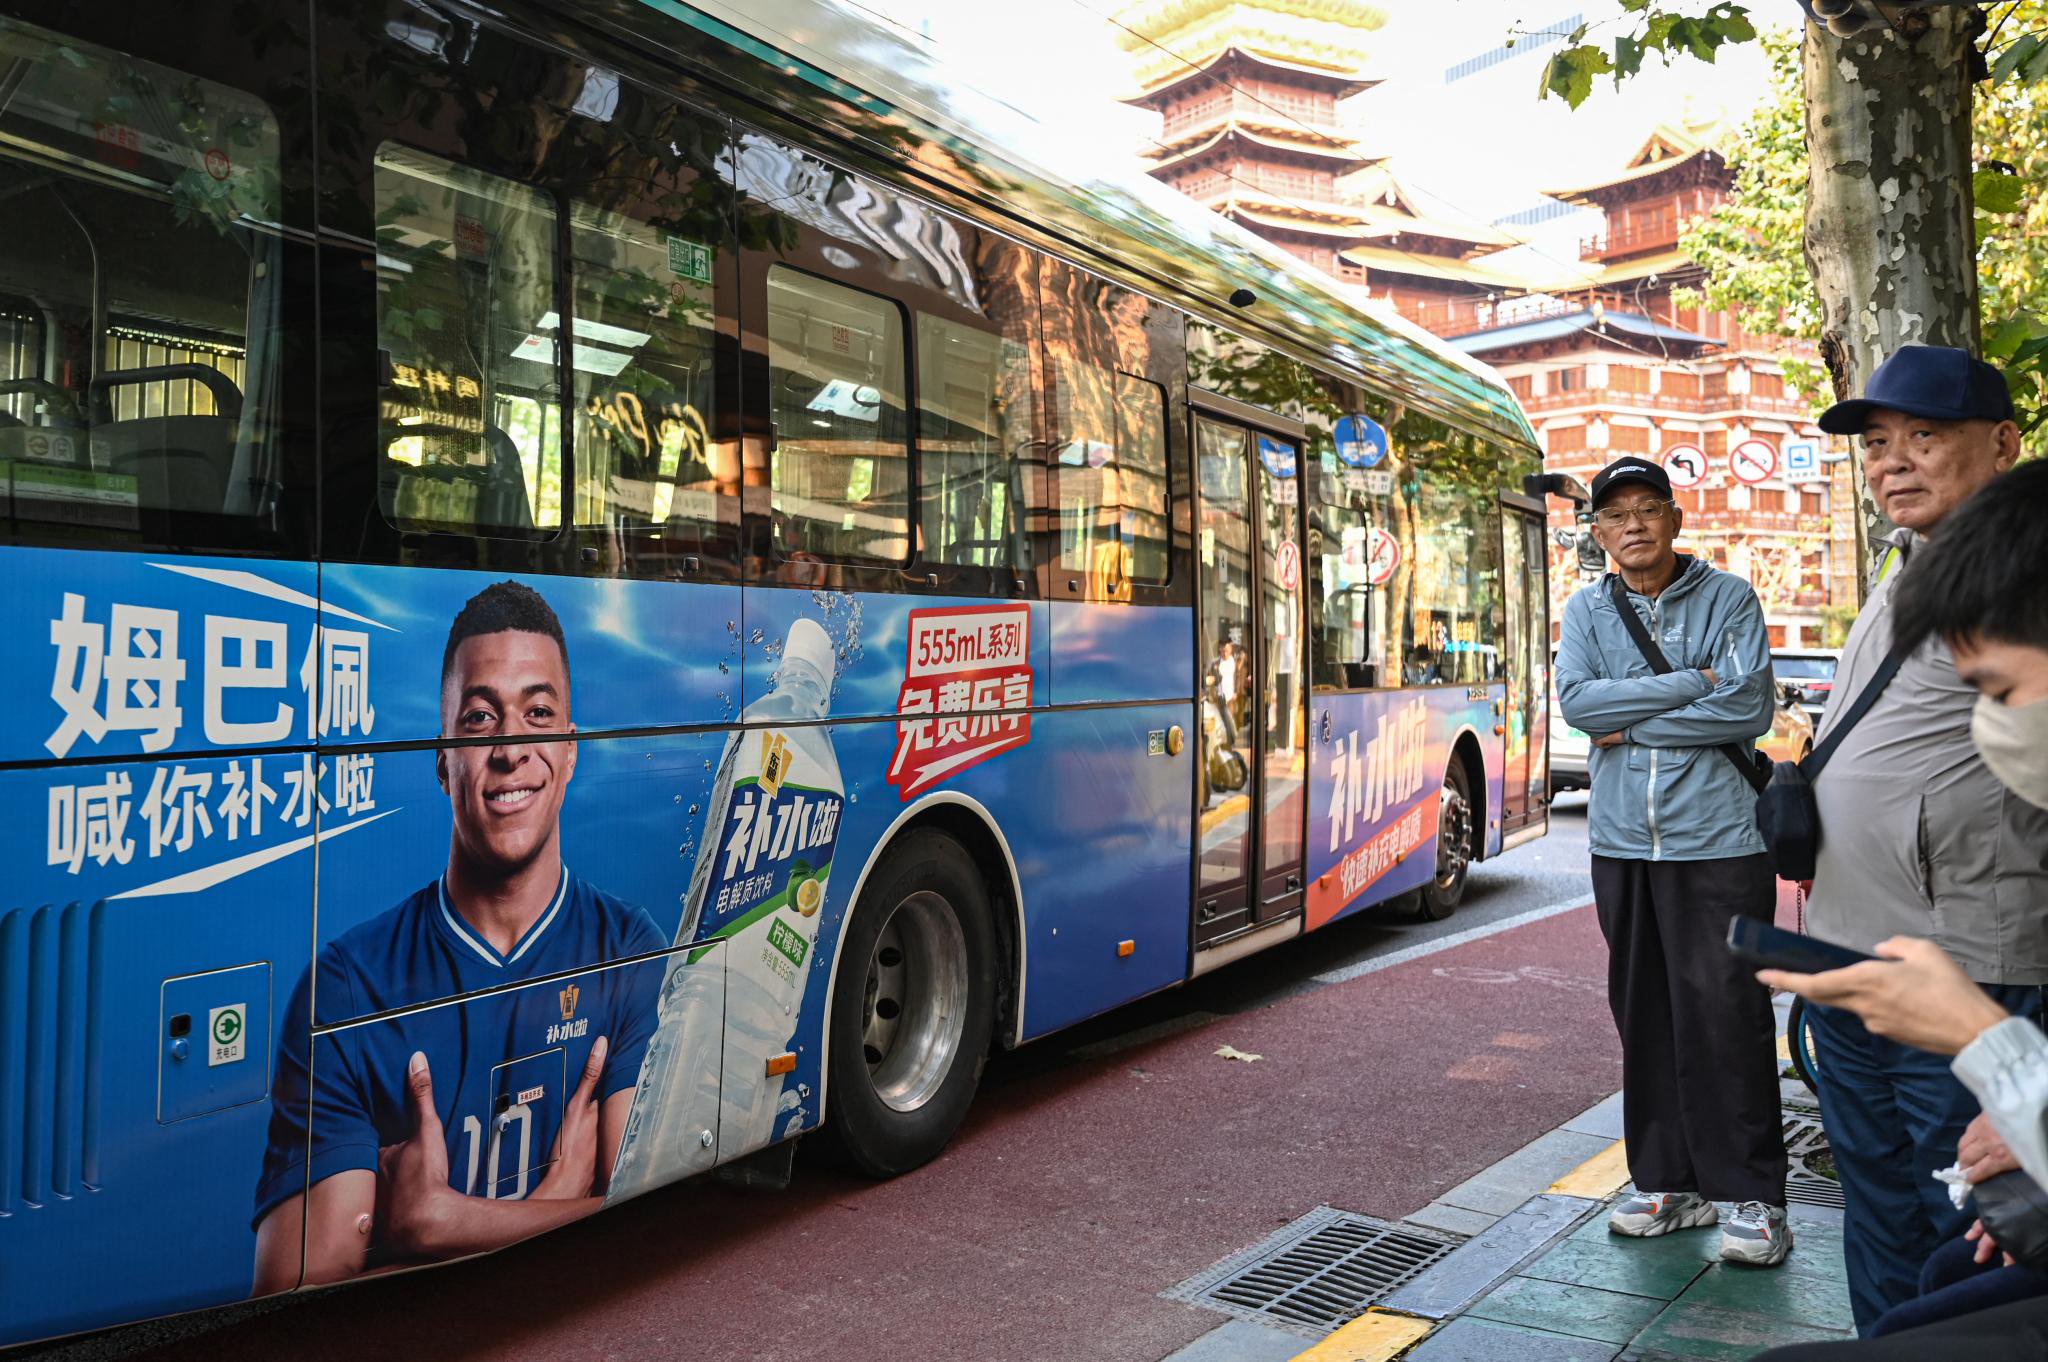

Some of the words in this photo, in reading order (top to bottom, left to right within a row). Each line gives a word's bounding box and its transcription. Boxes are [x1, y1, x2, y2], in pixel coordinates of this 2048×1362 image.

[44, 592, 375, 759] 姆巴佩
[917, 621, 1021, 667] 555mL系列
[890, 673, 1030, 777] 免费乐享
[47, 753, 376, 875] 喊你补水啦
[1328, 695, 1426, 853] 补水啦
[723, 791, 840, 881] 补水啦
[715, 869, 775, 915] 电解质饮料
[772, 921, 804, 963] 柠檬味
[216, 1046, 237, 1060] 充电口
[546, 1018, 588, 1044] 补水啦
[464, 1103, 532, 1200] 10
